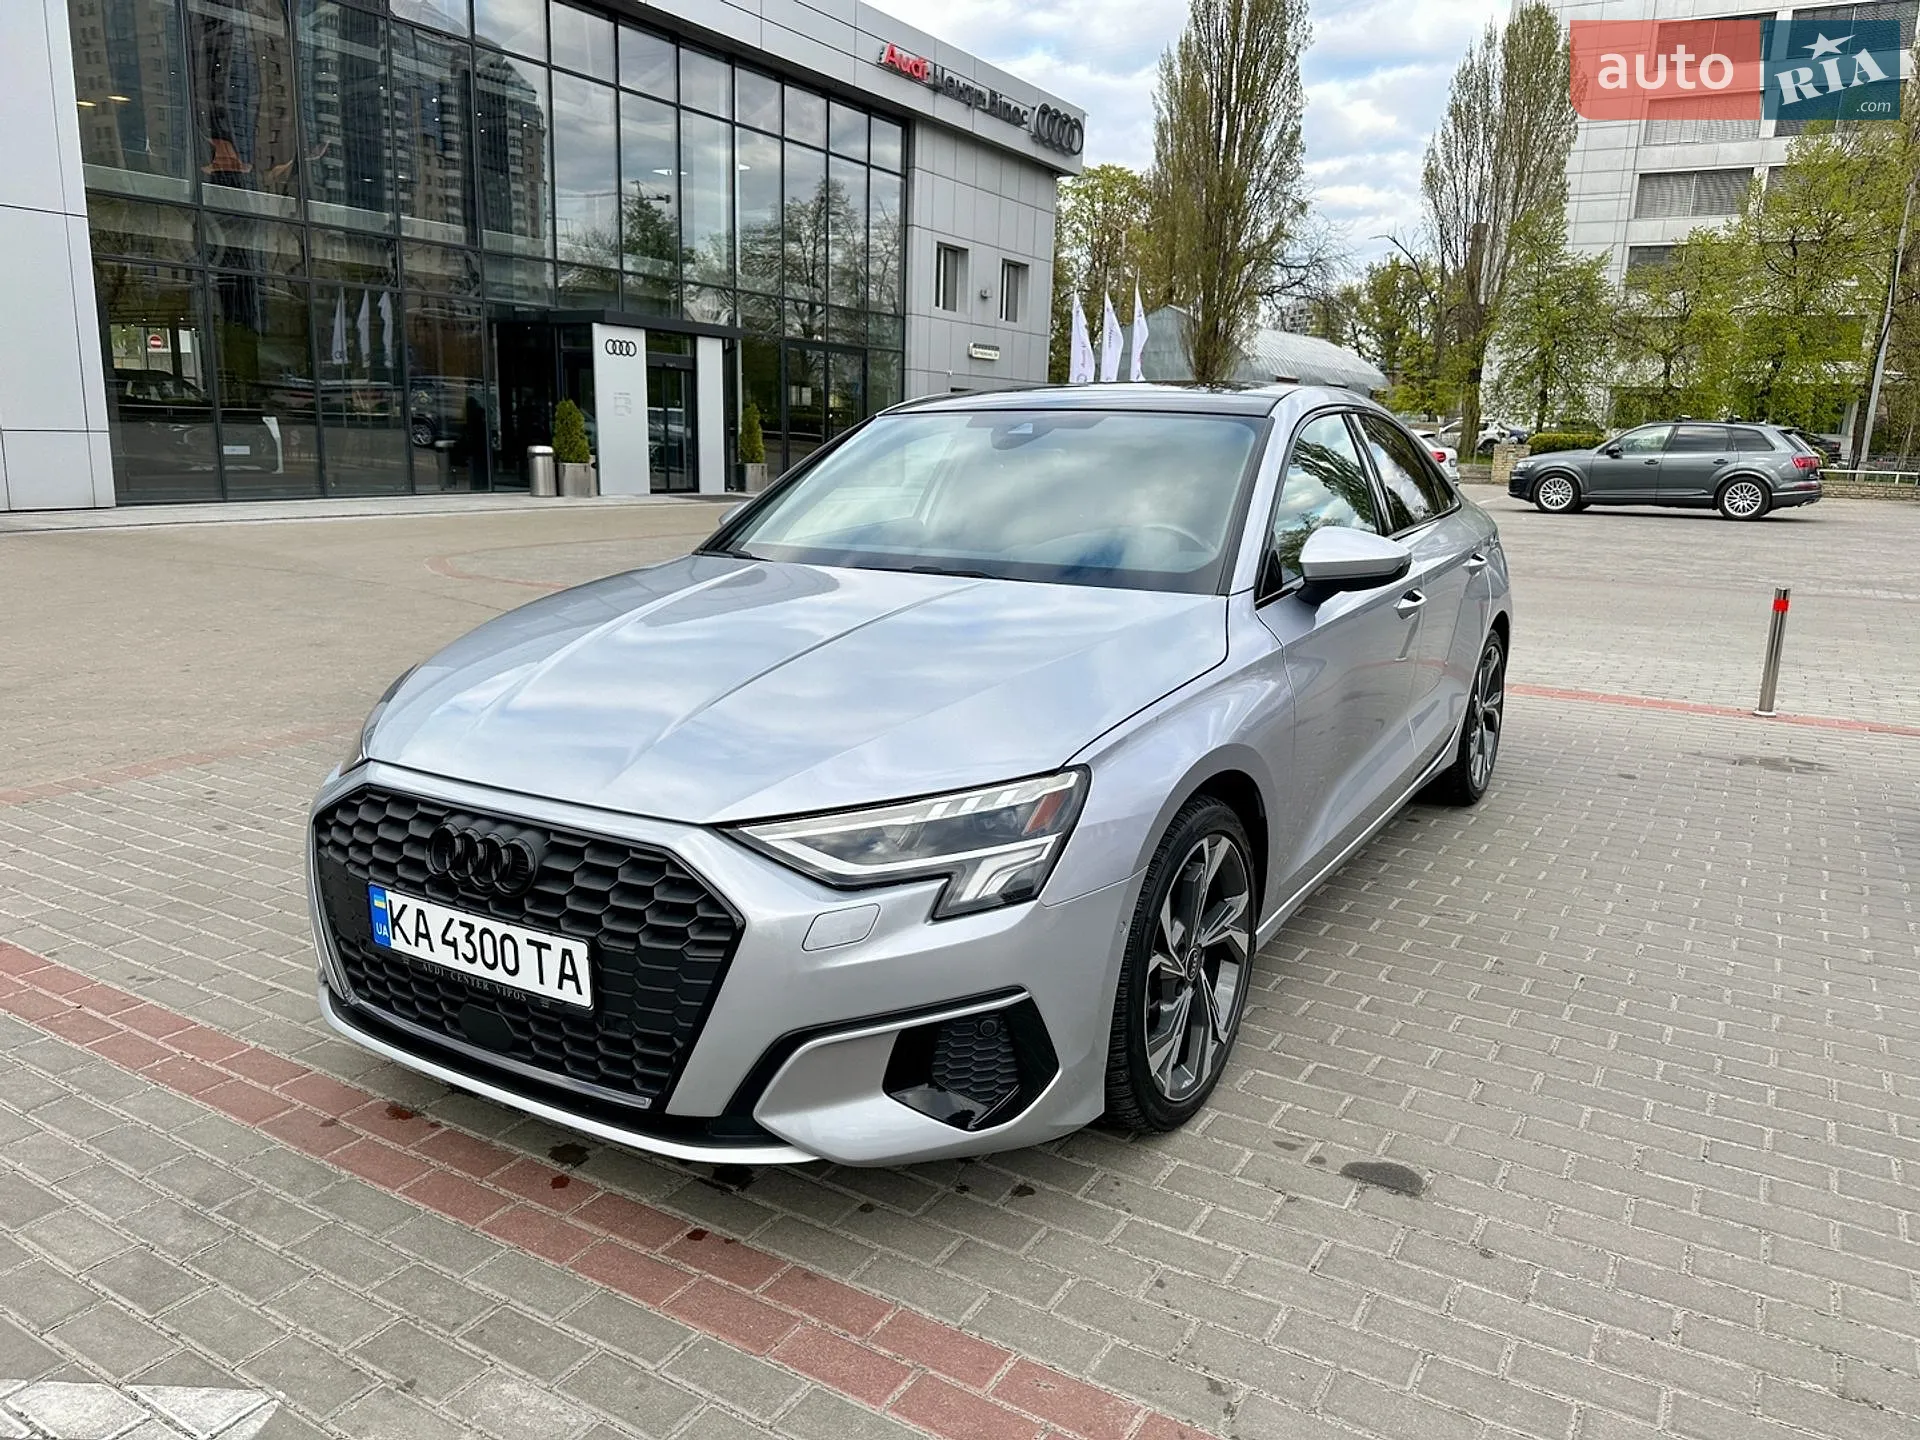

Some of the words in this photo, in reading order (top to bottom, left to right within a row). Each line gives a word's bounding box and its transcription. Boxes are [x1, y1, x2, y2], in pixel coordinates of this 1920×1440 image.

[885, 43, 929, 82] Audi
[375, 922, 389, 937] UA
[440, 917, 520, 977] 4300
